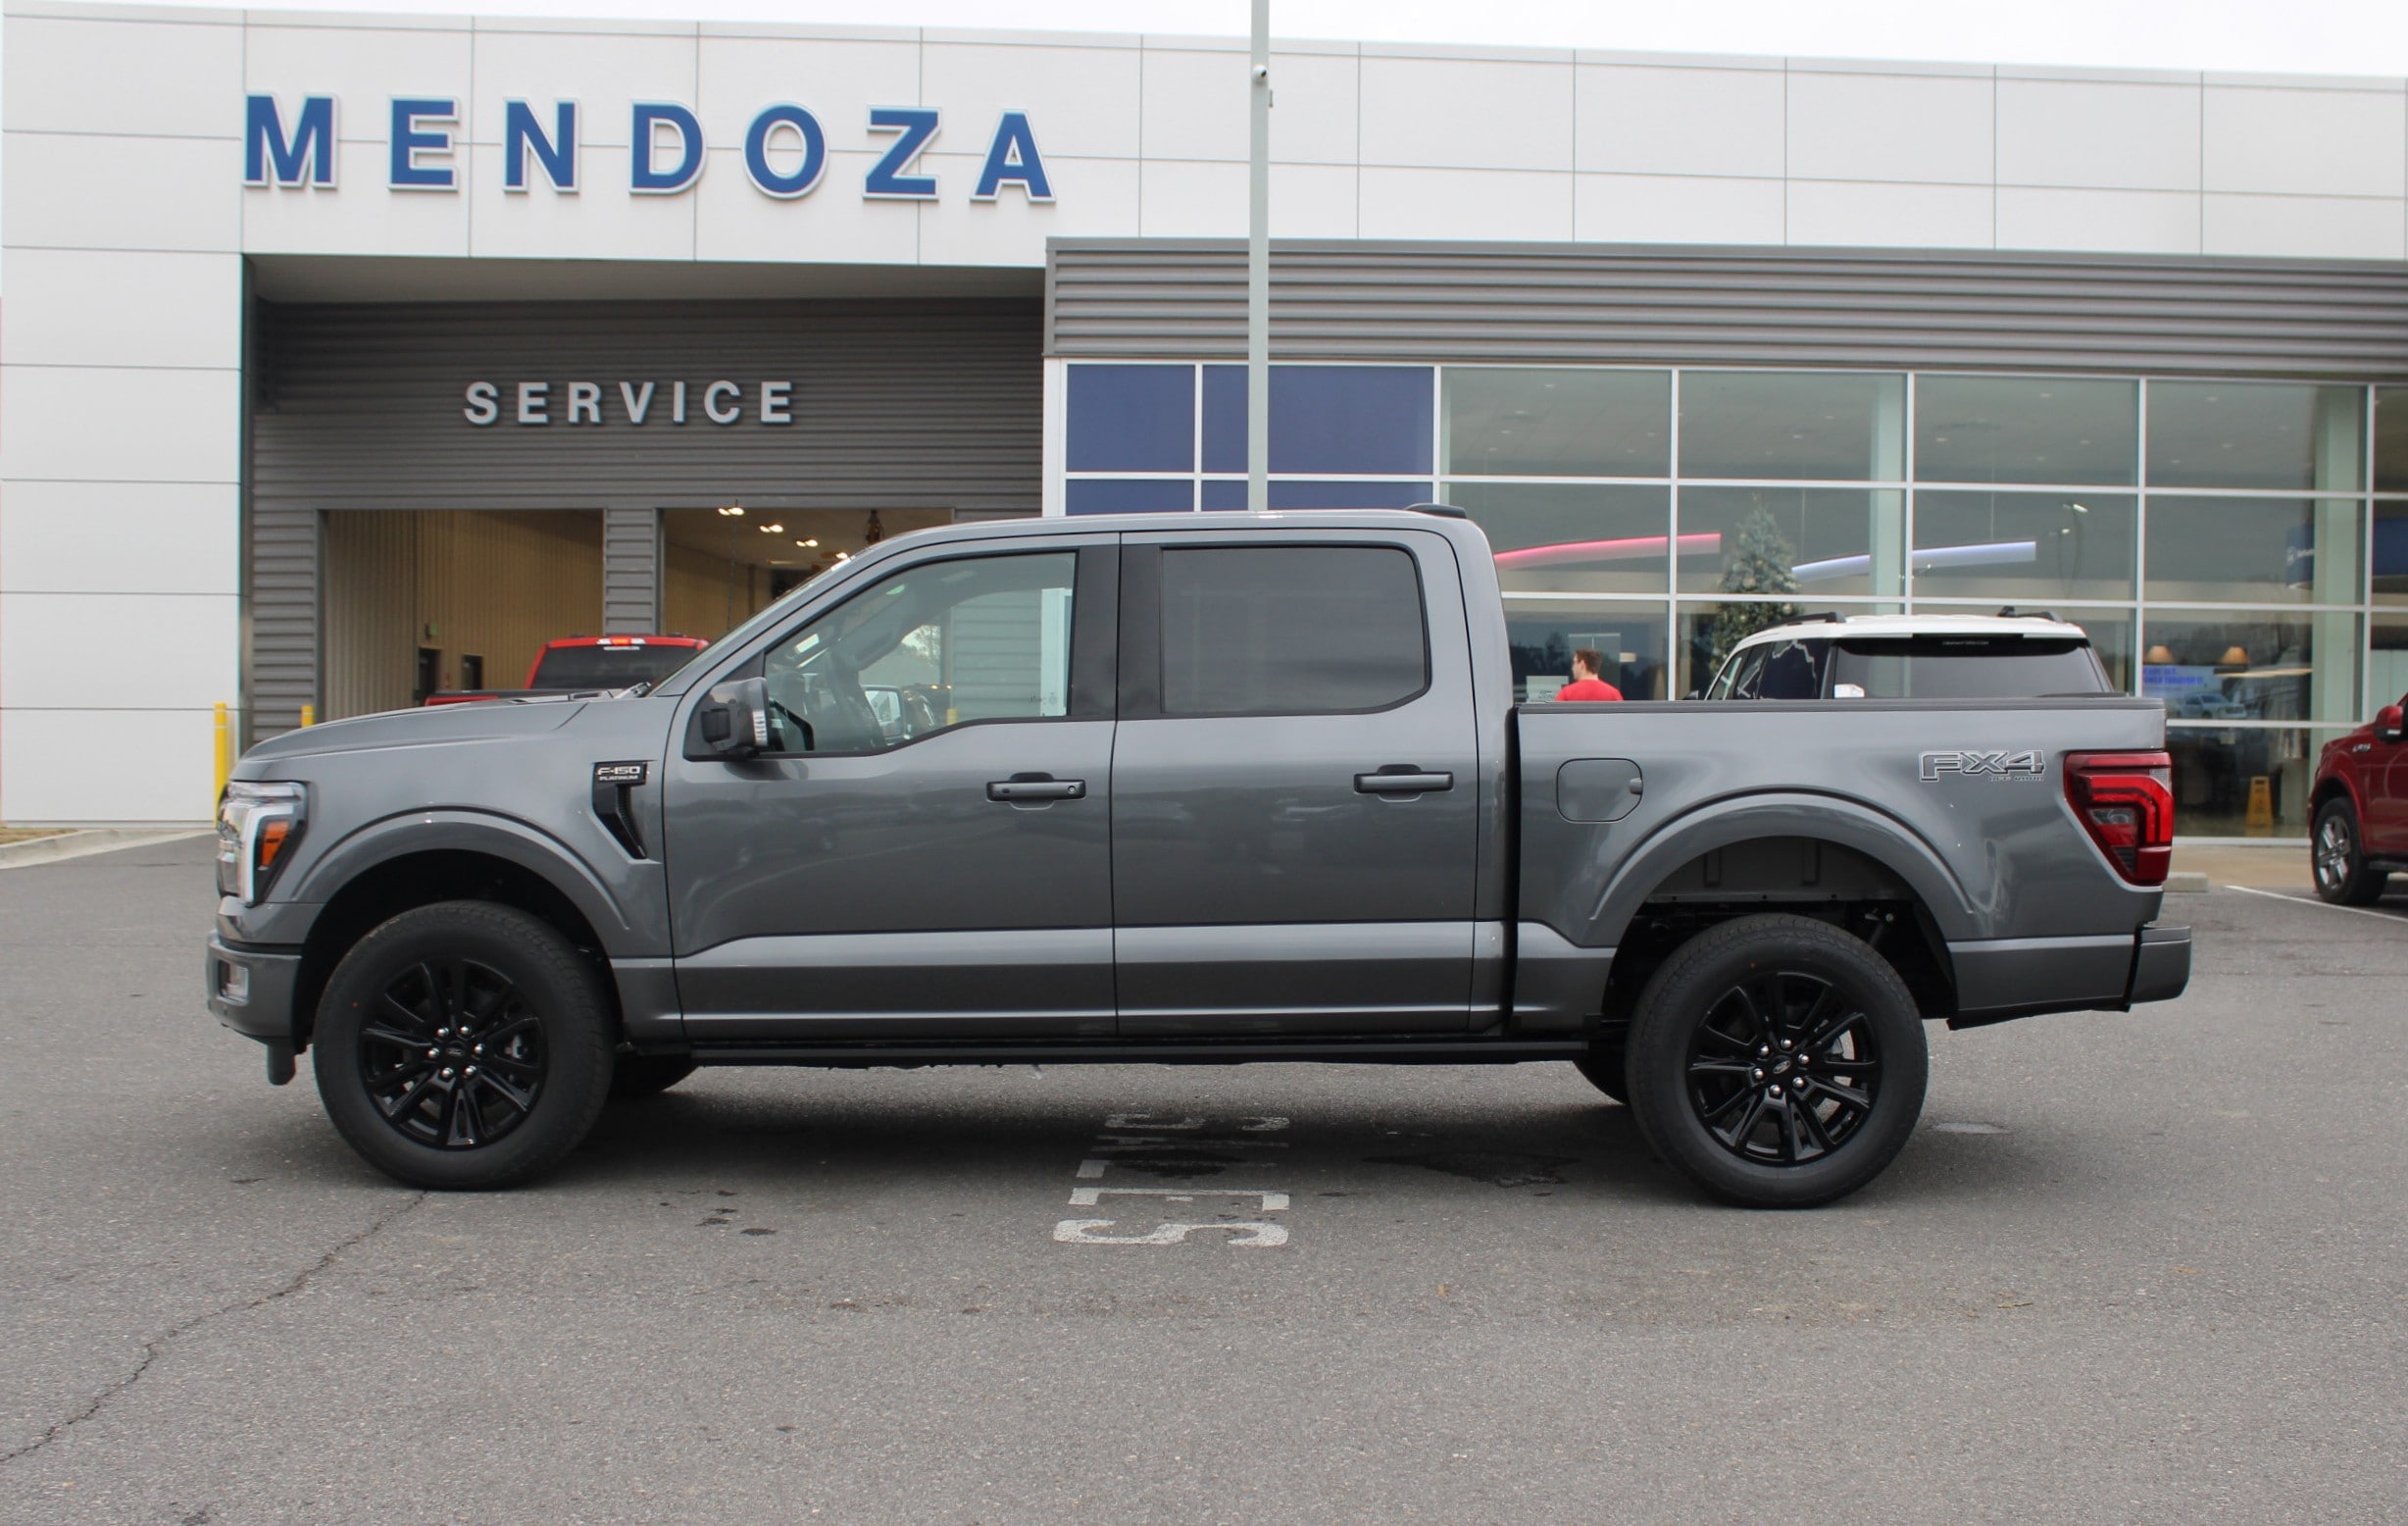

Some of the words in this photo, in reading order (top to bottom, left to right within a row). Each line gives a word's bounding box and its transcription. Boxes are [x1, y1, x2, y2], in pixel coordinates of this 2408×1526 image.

[243, 92, 1056, 203] MENDOZA
[464, 380, 792, 425] SERVICE
[597, 766, 640, 775] F-150
[1920, 750, 2045, 782] FX4
